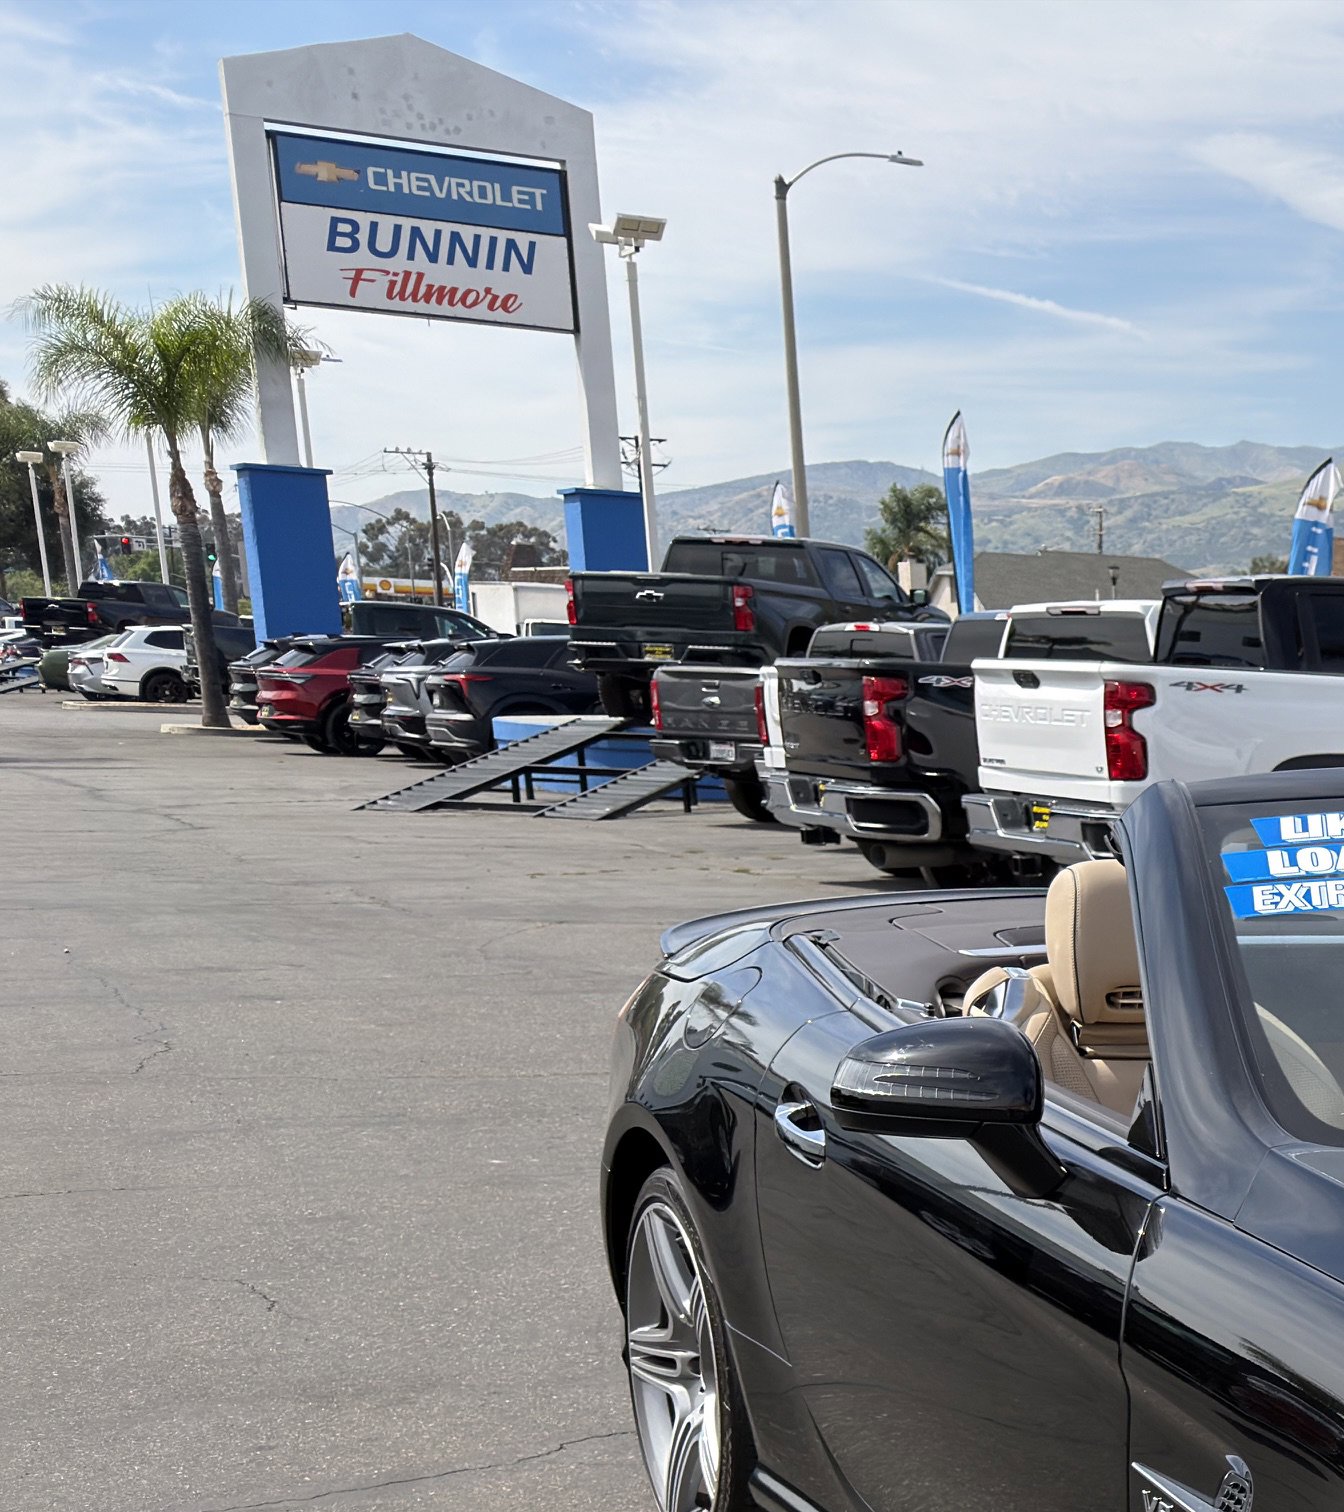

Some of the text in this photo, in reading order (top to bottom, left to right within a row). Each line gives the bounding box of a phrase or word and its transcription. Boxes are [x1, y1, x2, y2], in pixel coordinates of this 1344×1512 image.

[366, 166, 547, 211] CHEVROLET
[326, 215, 537, 275] BUNNIN
[339, 266, 523, 315] Fillmore
[981, 703, 1092, 728] CHEVROLET
